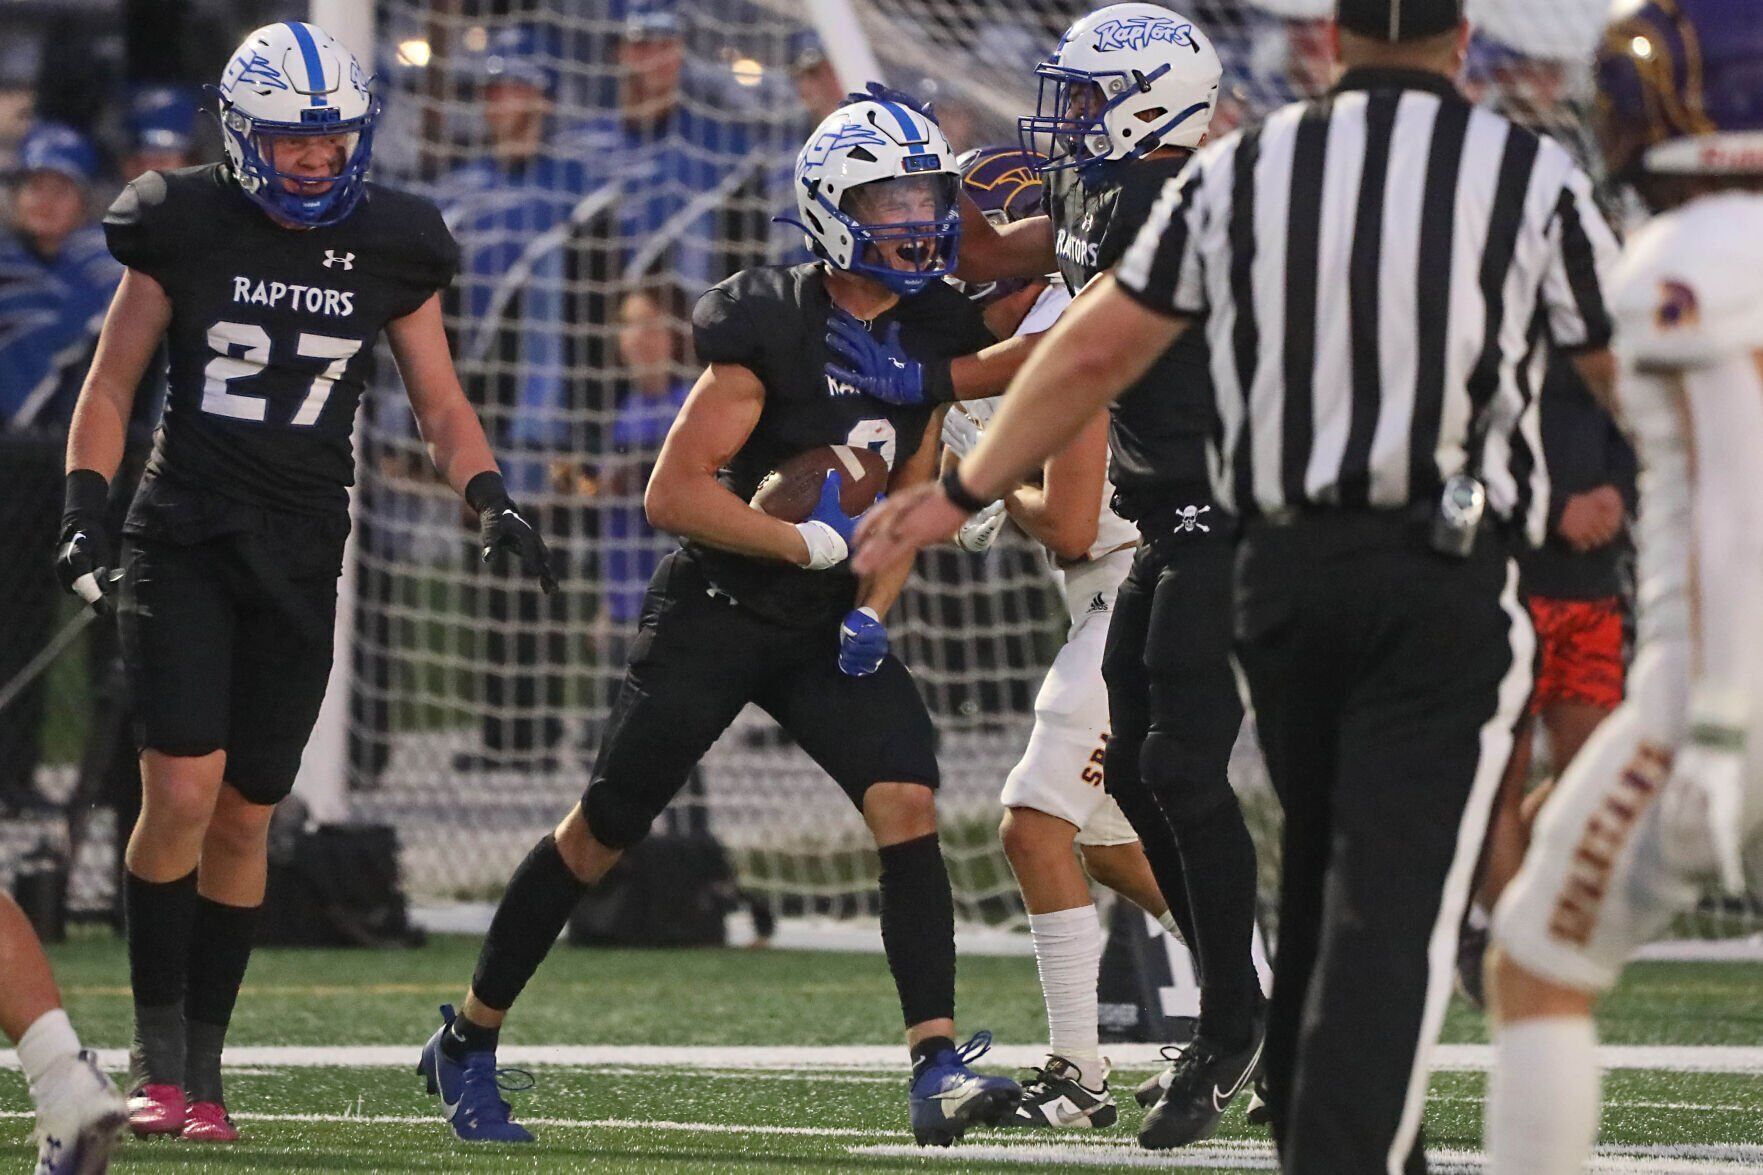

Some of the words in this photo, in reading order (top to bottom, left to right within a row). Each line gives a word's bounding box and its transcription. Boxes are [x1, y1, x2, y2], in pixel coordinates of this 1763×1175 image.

[1055, 228, 1100, 267] RATORS
[232, 276, 354, 317] RAPTORS
[201, 320, 363, 425] 27
